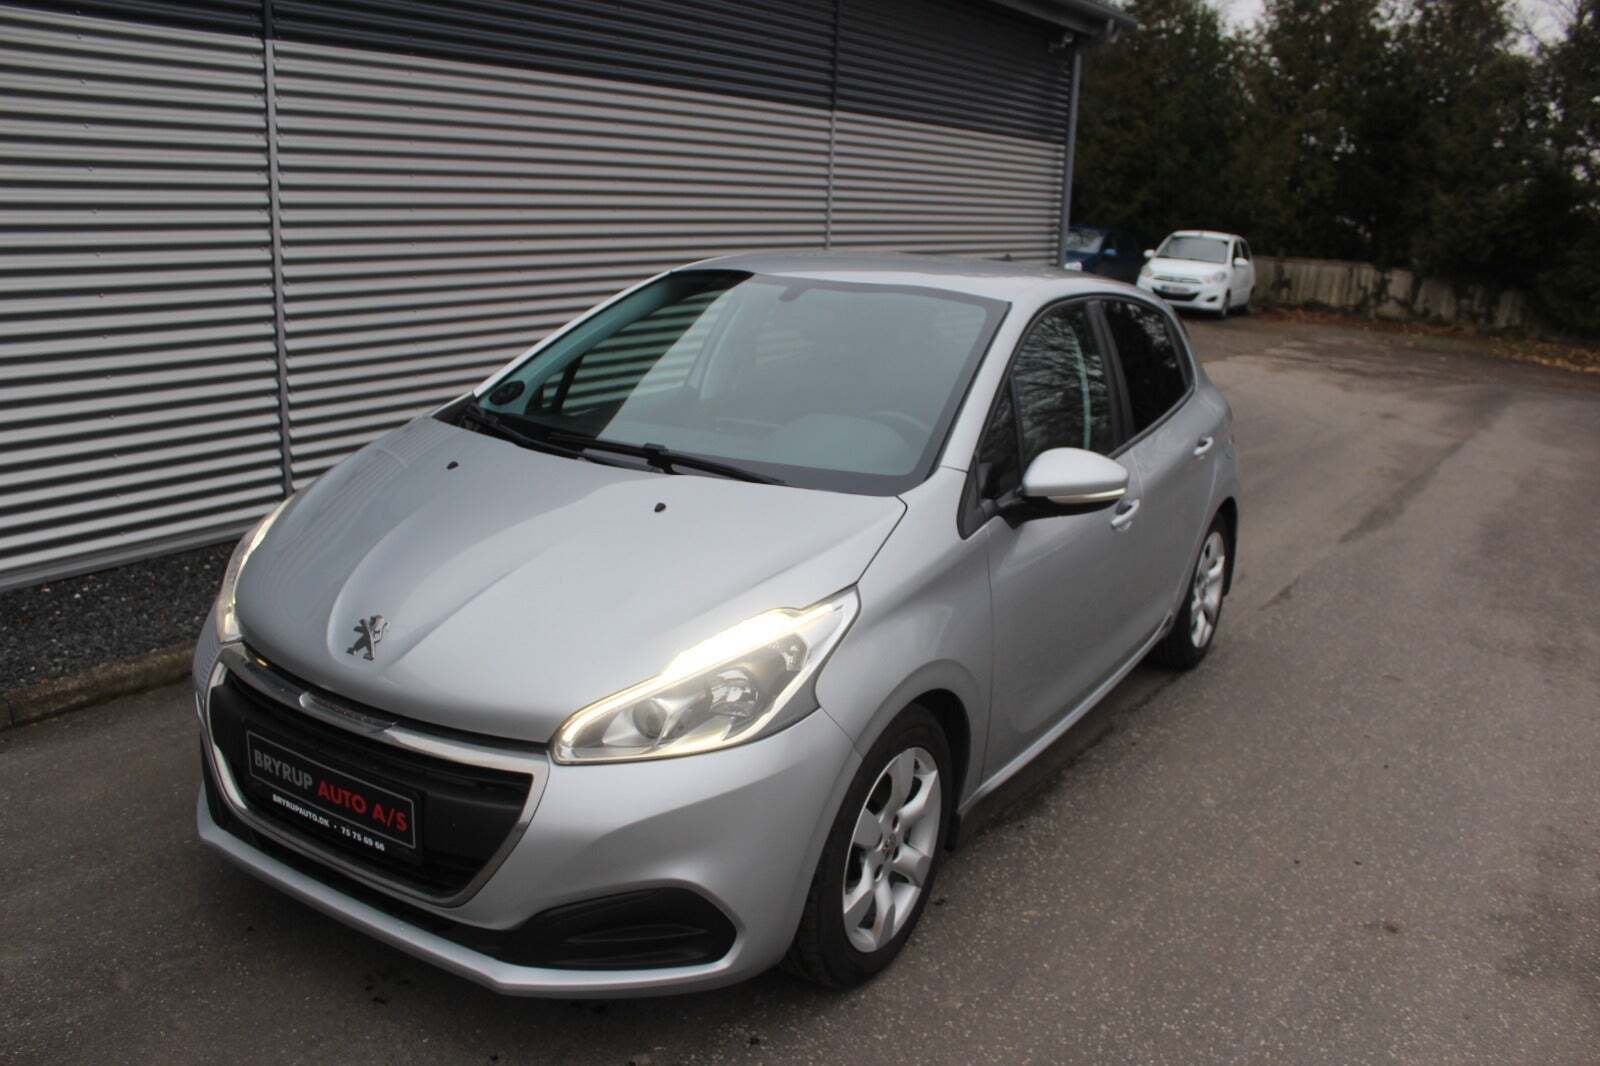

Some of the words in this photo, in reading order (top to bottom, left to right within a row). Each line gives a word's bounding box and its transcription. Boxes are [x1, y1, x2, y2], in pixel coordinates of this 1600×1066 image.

[254, 749, 312, 790] BRYRUP
[318, 780, 367, 814] AUTO
[373, 803, 408, 832] A/S
